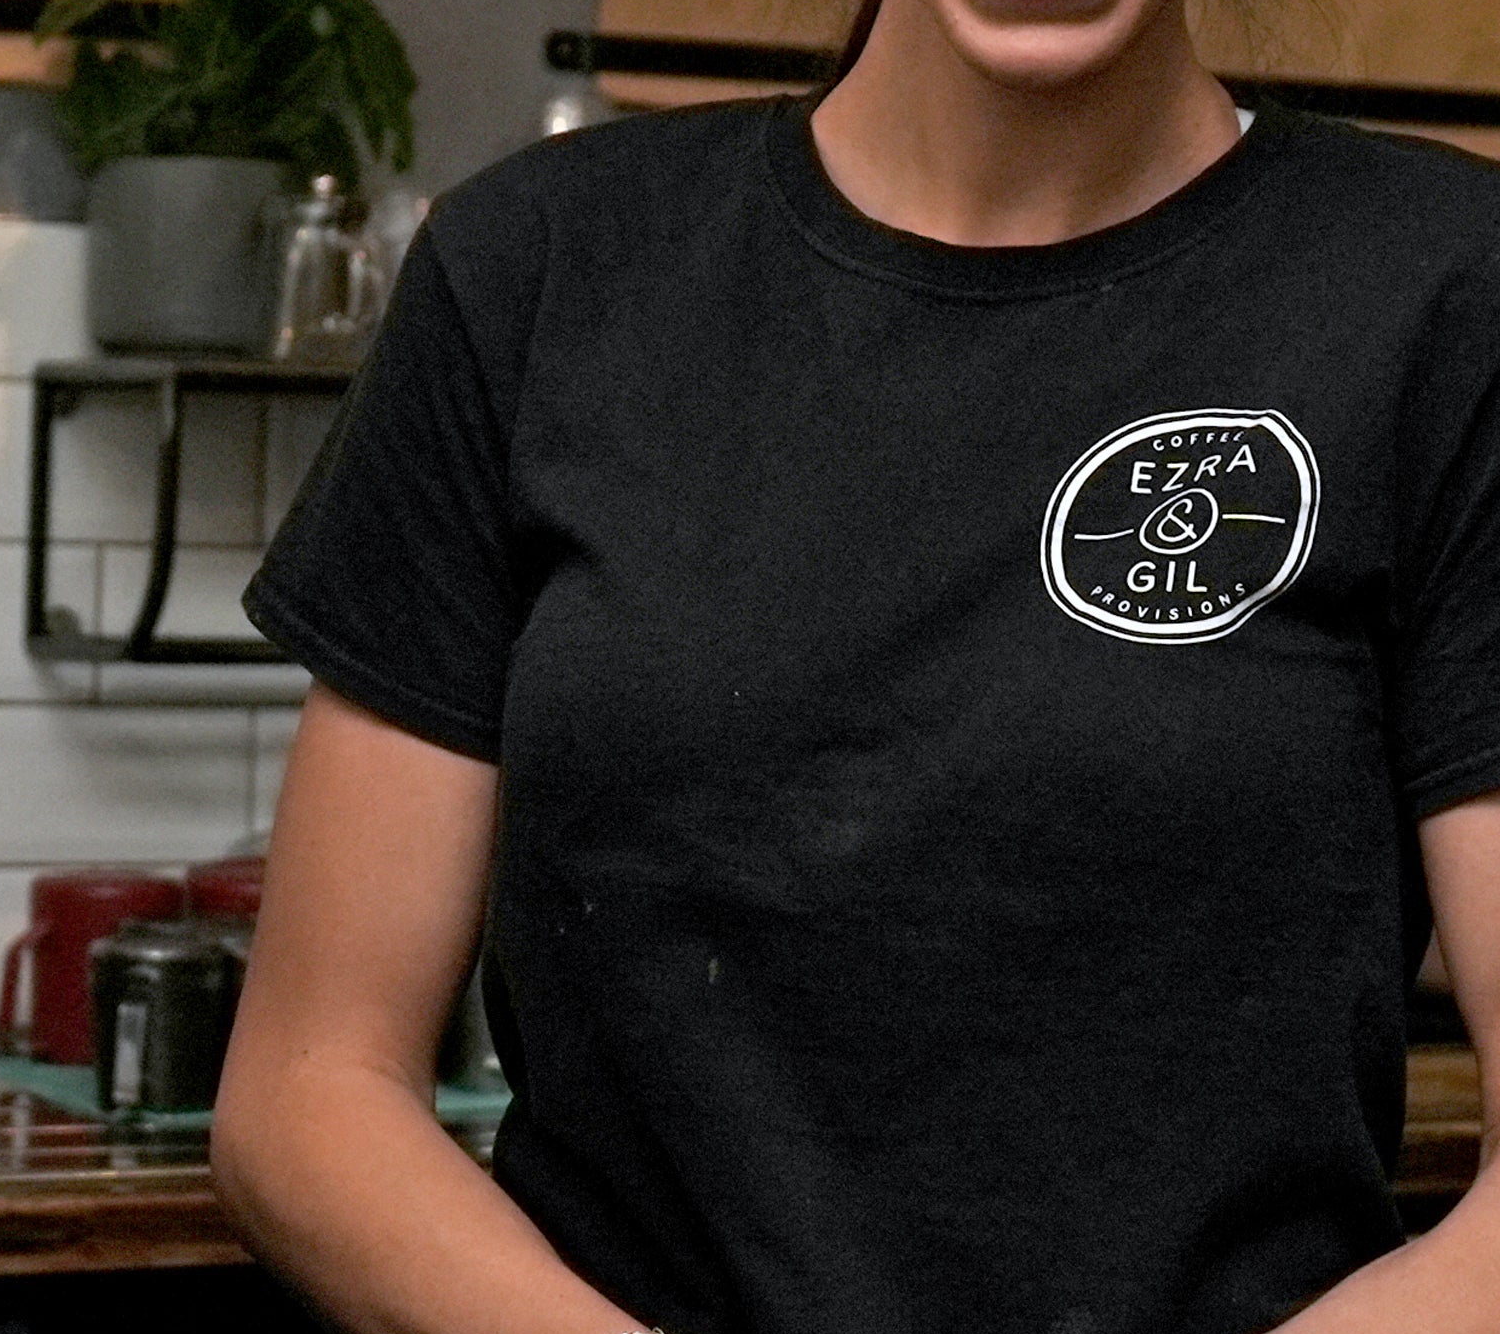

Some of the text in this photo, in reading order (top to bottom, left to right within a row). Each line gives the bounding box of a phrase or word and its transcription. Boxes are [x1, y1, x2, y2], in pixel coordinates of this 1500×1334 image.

[1153, 431, 1244, 451] COFFEE
[1131, 444, 1256, 494] EZRA
[1156, 498, 1197, 543] &
[1126, 560, 1208, 593] GIL
[1090, 583, 1246, 620] PROVISIONS
